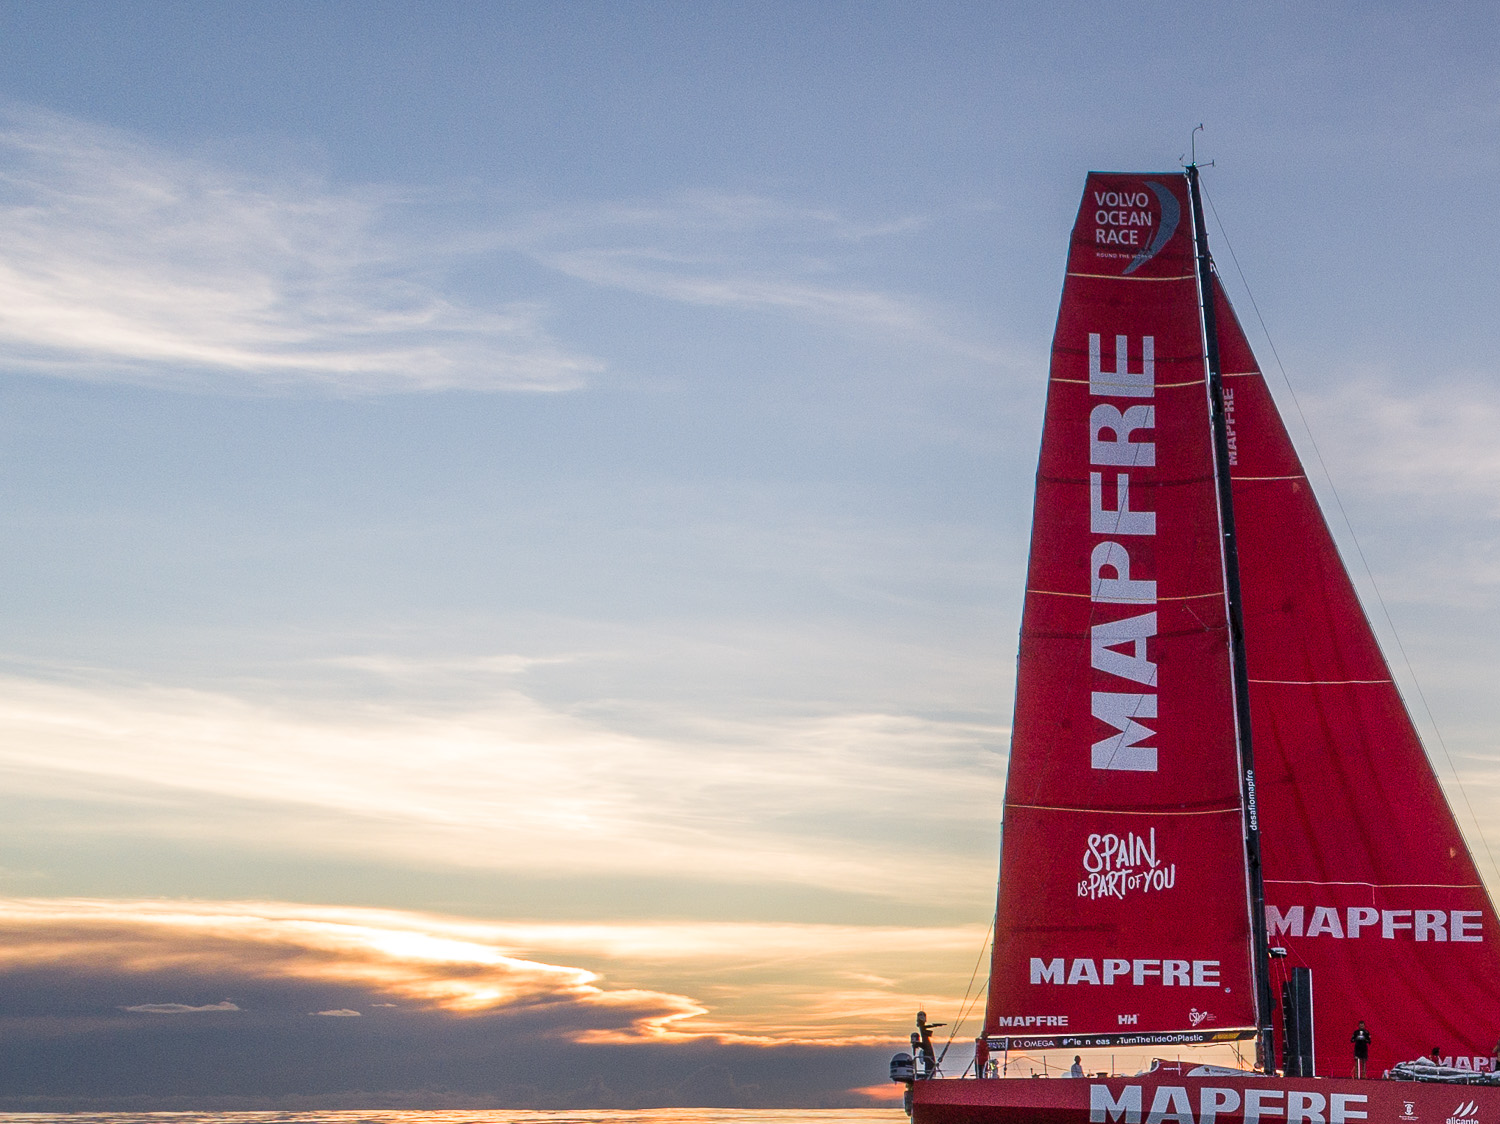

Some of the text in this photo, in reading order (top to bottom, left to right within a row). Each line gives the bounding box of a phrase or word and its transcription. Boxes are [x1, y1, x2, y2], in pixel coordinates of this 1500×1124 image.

[1094, 191, 1149, 208] VOLVO
[1095, 210, 1152, 227] OCEAN
[1095, 229, 1139, 245] RACE
[1223, 387, 1238, 466] MAPFRE
[1088, 333, 1158, 772] MAPFRE
[1077, 863, 1176, 901] IS PART OF YOU
[1264, 905, 1483, 942] MAPFRE
[1029, 957, 1221, 987] MAPFRE
[999, 1015, 1069, 1027] MAPFRE
[1023, 1040, 1055, 1048] OMEGA
[1116, 1034, 1204, 1045] TurnTheTideOnPlastic
